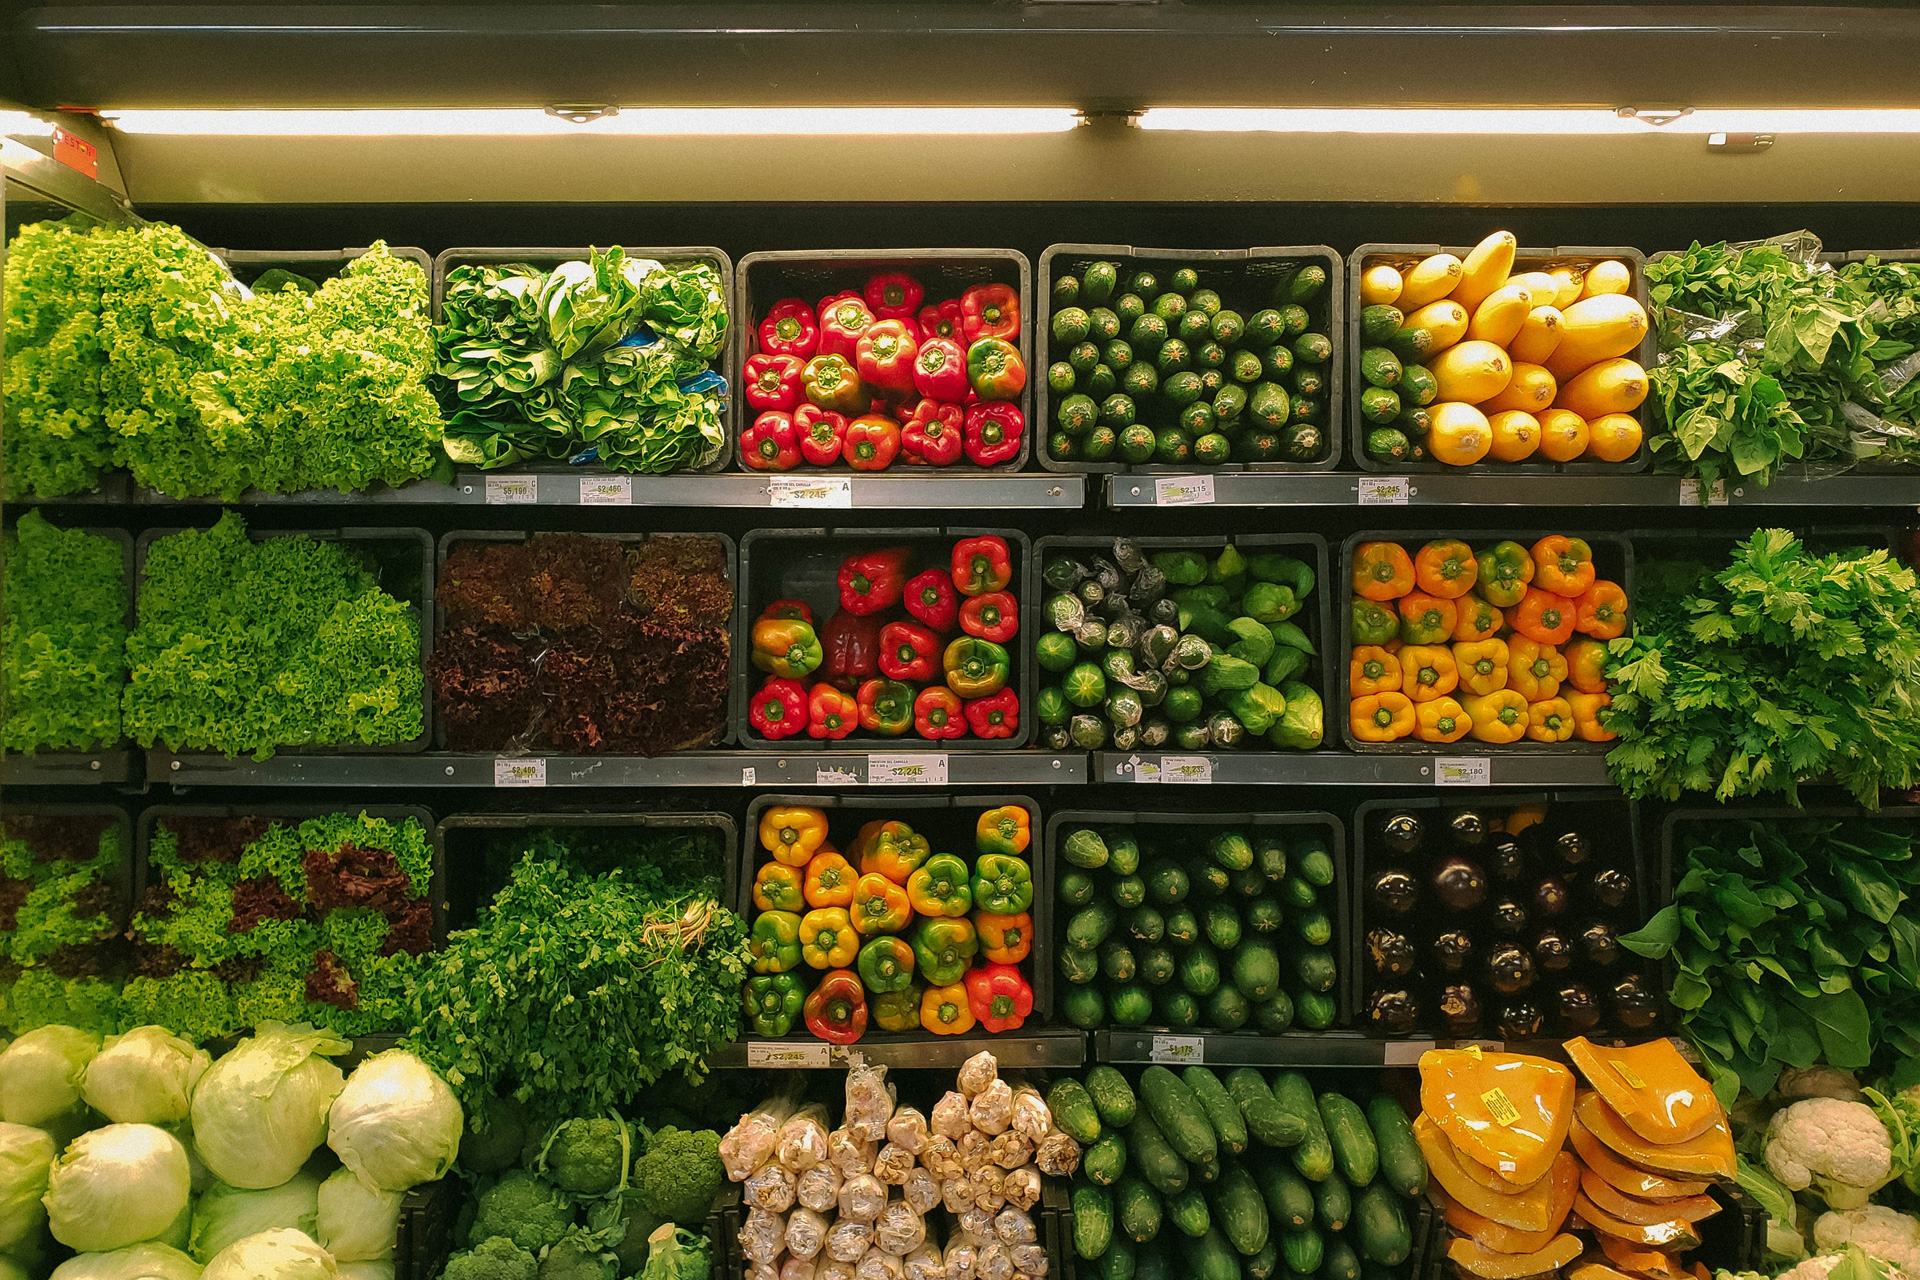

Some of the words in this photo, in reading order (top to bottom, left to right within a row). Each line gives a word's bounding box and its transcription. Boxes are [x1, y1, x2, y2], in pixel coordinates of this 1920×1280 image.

[842, 482, 850, 491] A
[540, 758, 545, 766] C
[938, 759, 945, 767] A
[891, 767, 923, 777] $2,245
[1197, 1038, 1202, 1046] A
